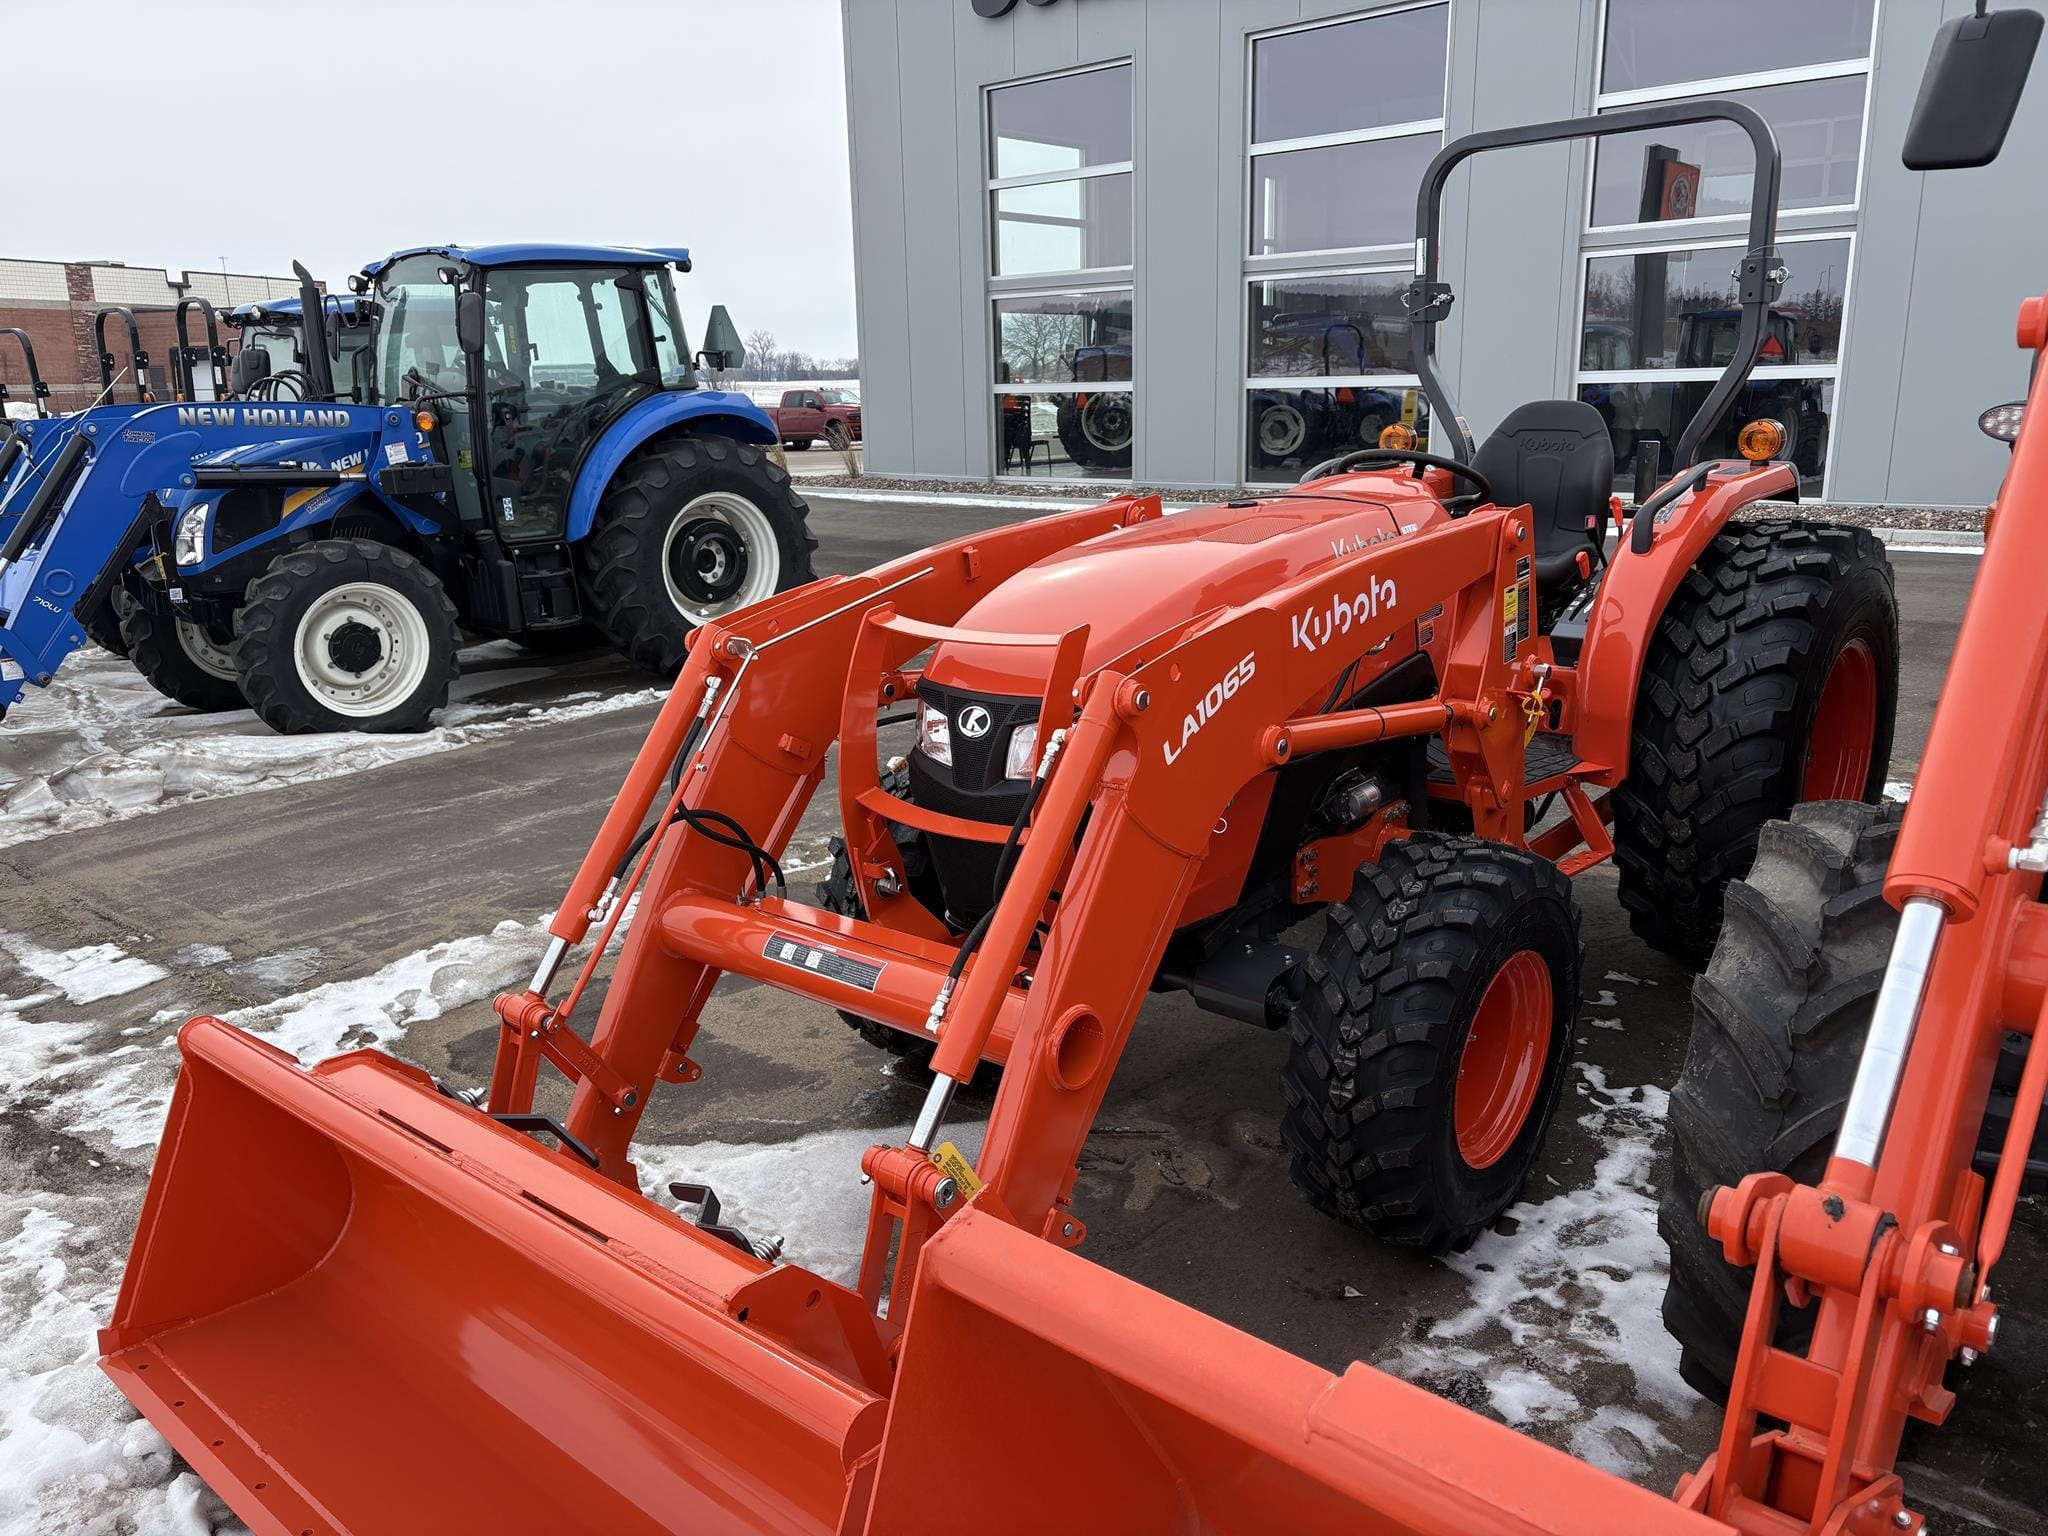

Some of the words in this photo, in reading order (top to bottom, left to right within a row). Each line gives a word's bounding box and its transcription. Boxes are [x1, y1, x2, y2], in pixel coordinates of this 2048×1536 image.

[178, 407, 236, 427] NEW
[243, 408, 351, 428] HOLLAND
[122, 429, 155, 438] JOHNSON
[123, 435, 155, 443] TRACTOR
[1520, 437, 1576, 452] Kubota
[331, 451, 362, 472] NEW
[33, 596, 62, 613] 710LU
[1291, 575, 1397, 652] Kubota
[1163, 650, 1256, 766] LA1065
